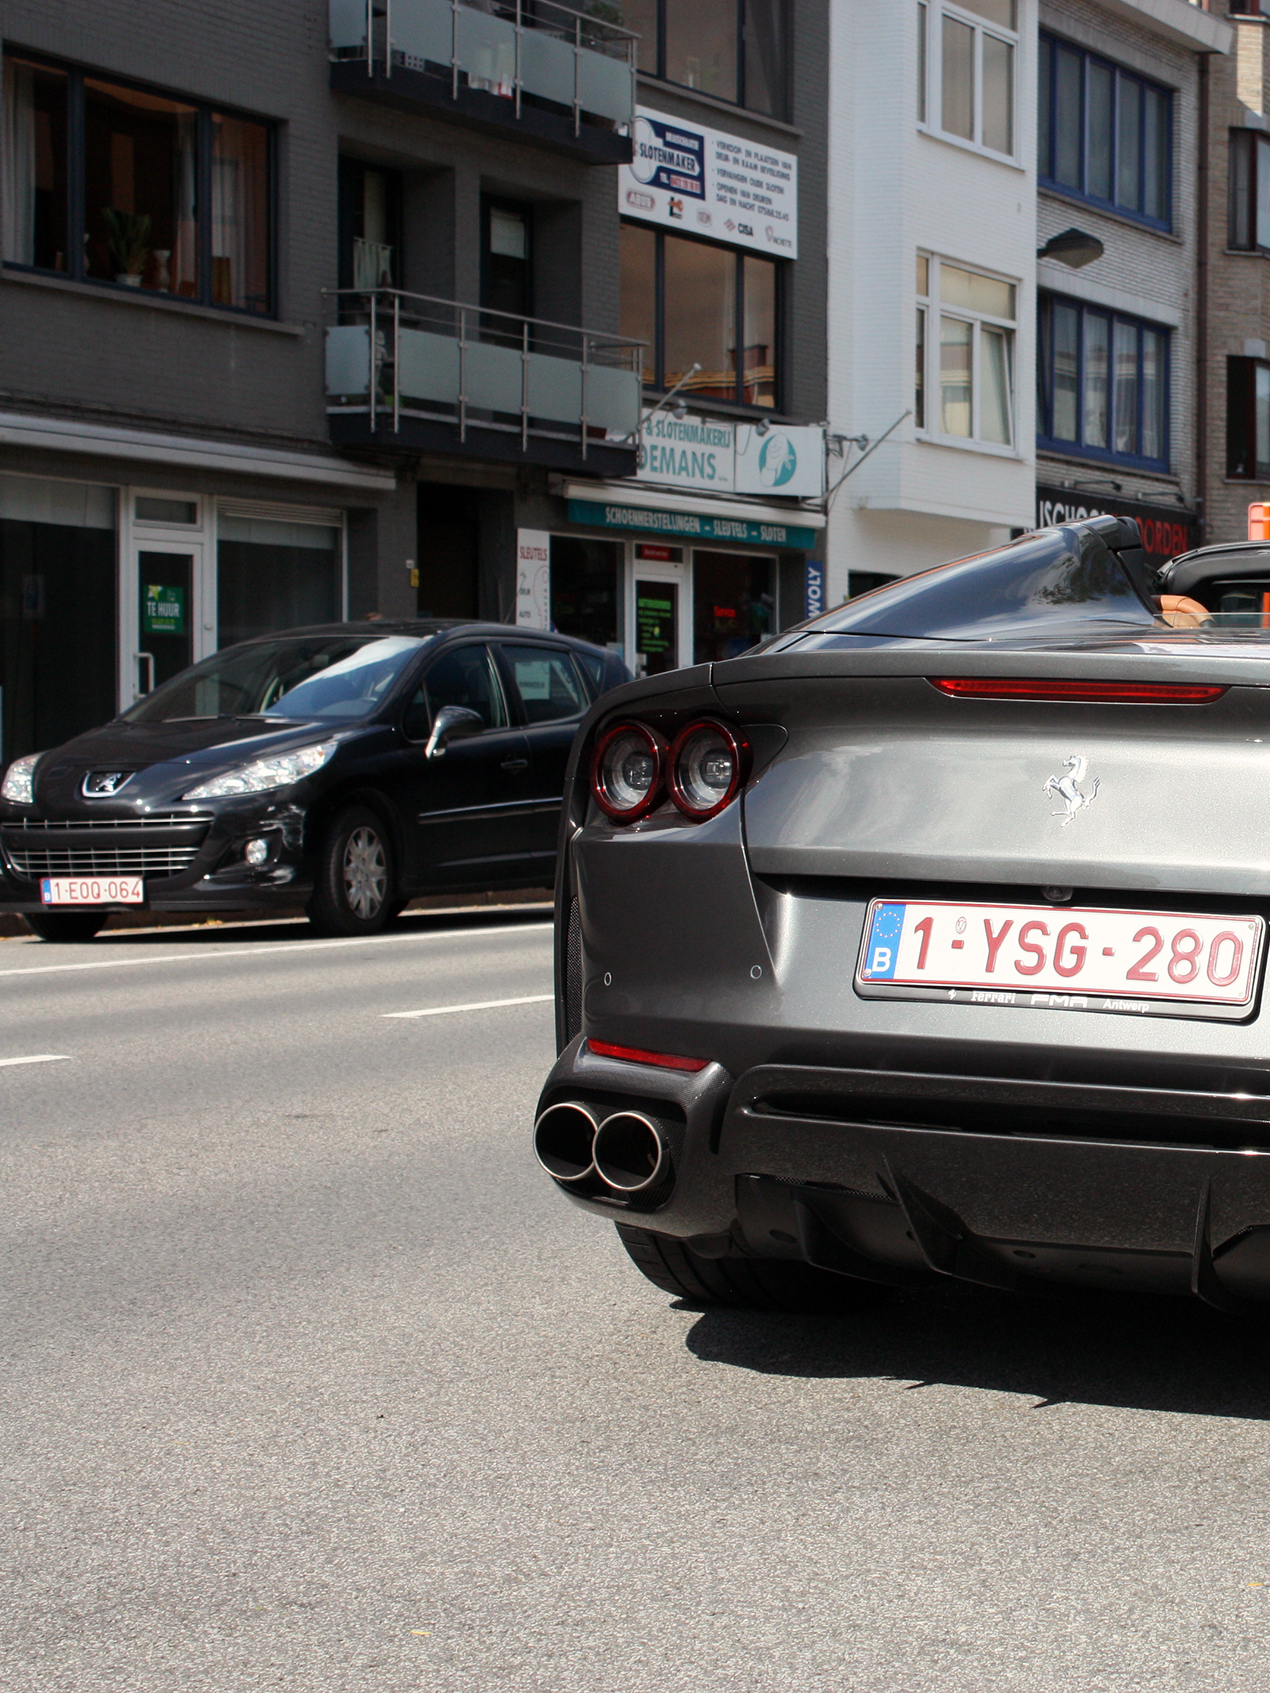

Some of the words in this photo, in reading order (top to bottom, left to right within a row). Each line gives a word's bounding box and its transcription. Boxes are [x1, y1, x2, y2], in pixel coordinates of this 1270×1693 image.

[640, 143, 696, 173] SLOTENMAKER
[737, 223, 754, 237] CISA
[656, 419, 731, 449] SLOTENMAKERIJ
[605, 507, 700, 533] SCHOENHERSTELLINGEN
[714, 519, 747, 539] SLEUTELS
[760, 525, 787, 542] SLOTEN
[519, 546, 548, 561] SLEUTELS
[808, 567, 821, 617] WOLY
[147, 601, 157, 617] TE
[158, 602, 180, 617] HUUR
[713, 605, 736, 618] Service
[871, 947, 892, 972] B
[914, 916, 1244, 986] 1-YSG-280
[971, 989, 1016, 1004] Ferrari
[1030, 994, 1088, 1009] FMA
[1102, 998, 1150, 1014] Antwerp
